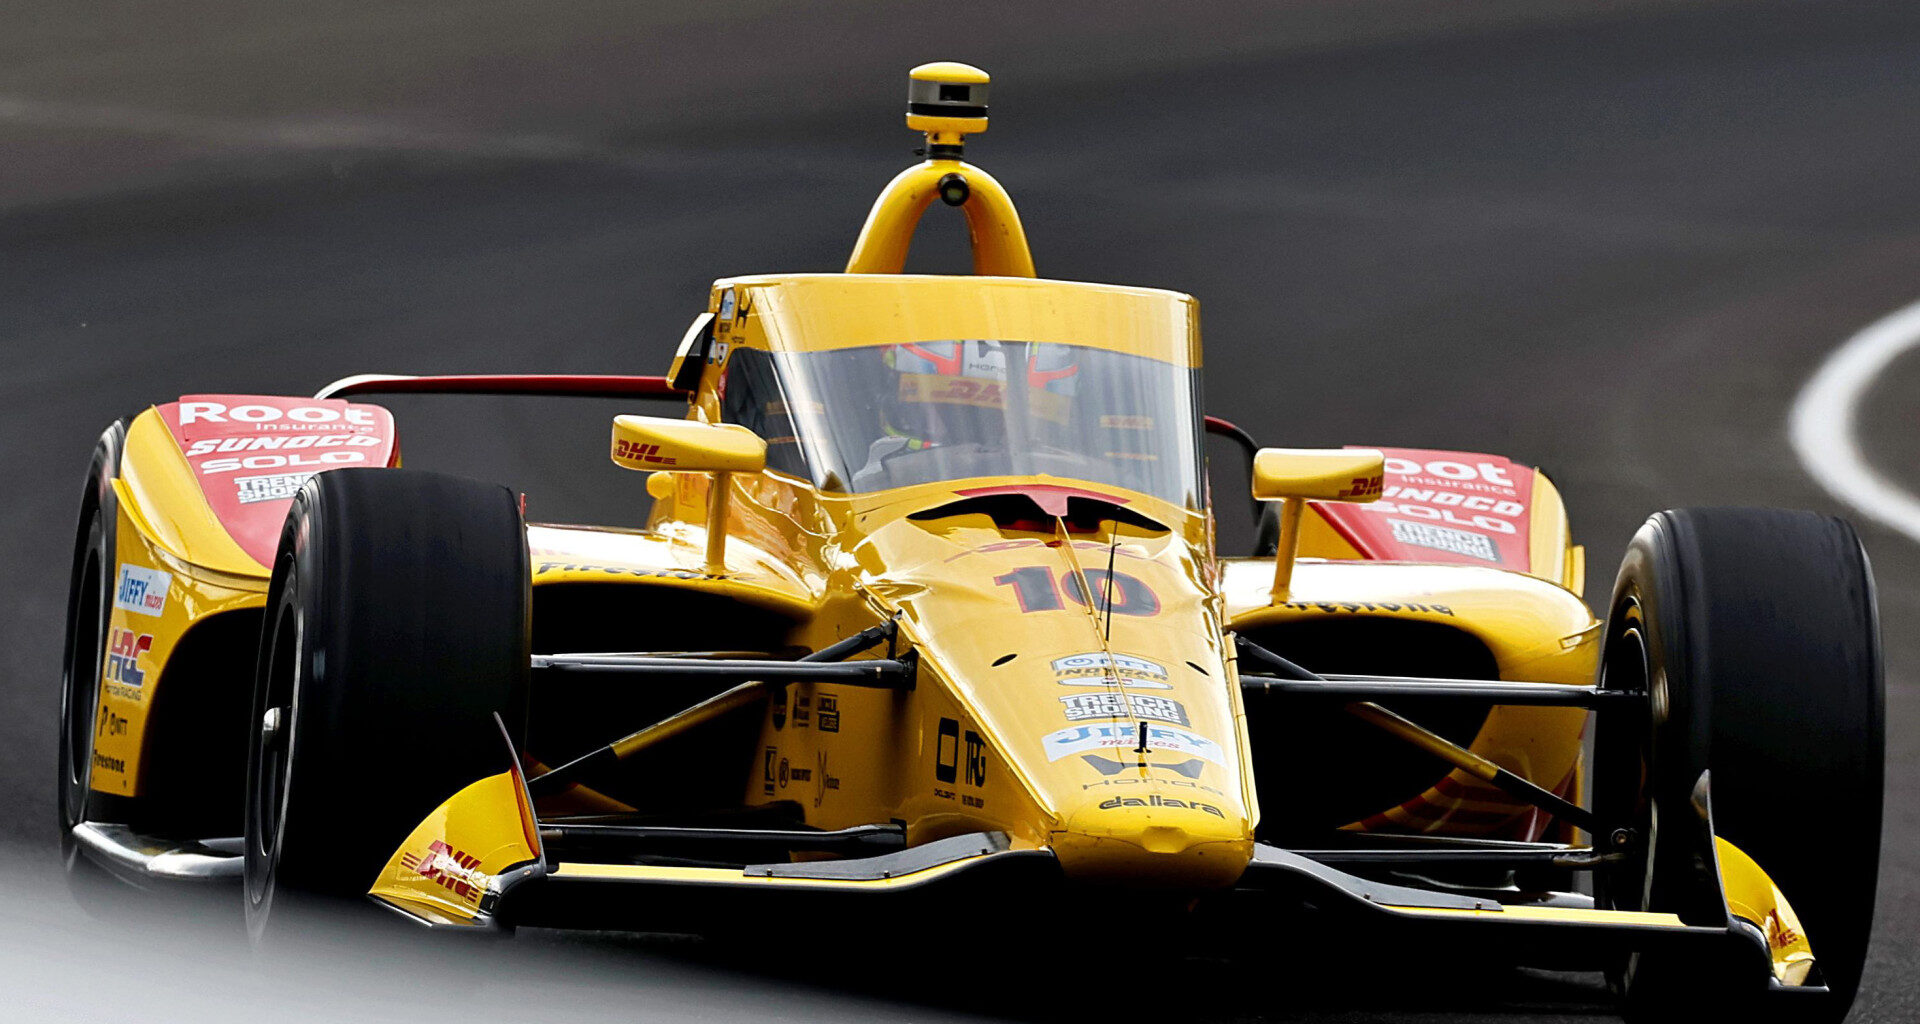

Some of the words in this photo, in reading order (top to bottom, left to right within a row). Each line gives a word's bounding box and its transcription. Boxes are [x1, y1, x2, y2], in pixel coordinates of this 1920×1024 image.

[186, 434, 382, 456] SUNOCO
[616, 439, 666, 464] DHL
[201, 451, 365, 474] SOLO
[1384, 458, 1513, 487] oot
[234, 473, 312, 490] TREN
[1347, 476, 1384, 497] DH
[1401, 475, 1517, 497] Insurance
[237, 486, 300, 501] SHOR
[1360, 501, 1517, 534] SOLO
[118, 569, 149, 606] JIFFY
[993, 565, 1162, 617] 10
[1059, 693, 1176, 709] TRENCH
[1064, 704, 1182, 723] SHORING
[1055, 726, 1212, 747] JIFFY
[1099, 795, 1226, 819] dallara
